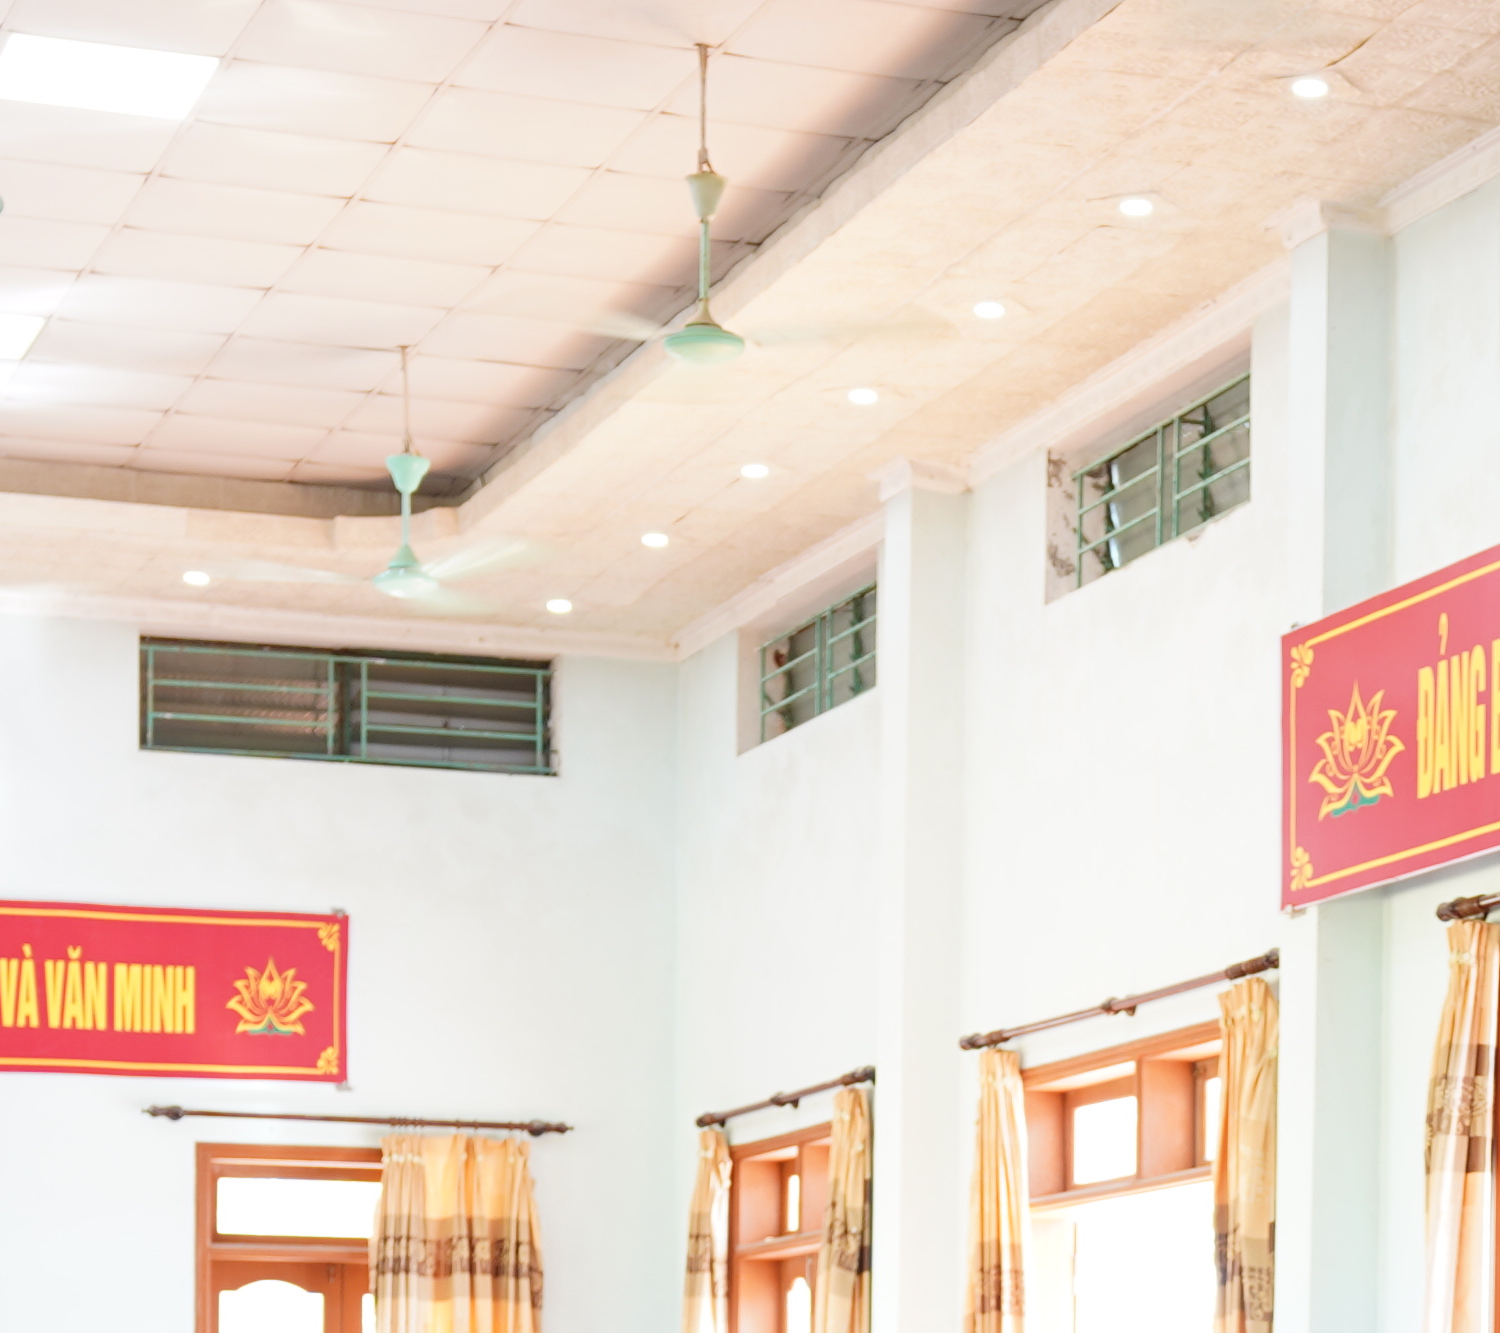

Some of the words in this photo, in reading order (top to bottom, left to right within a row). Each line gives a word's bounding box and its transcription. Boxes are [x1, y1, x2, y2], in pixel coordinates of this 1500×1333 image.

[1414, 612, 1487, 800] ĐẢNG
[43, 945, 109, 1032] VĂN
[113, 962, 197, 1035] MINH
